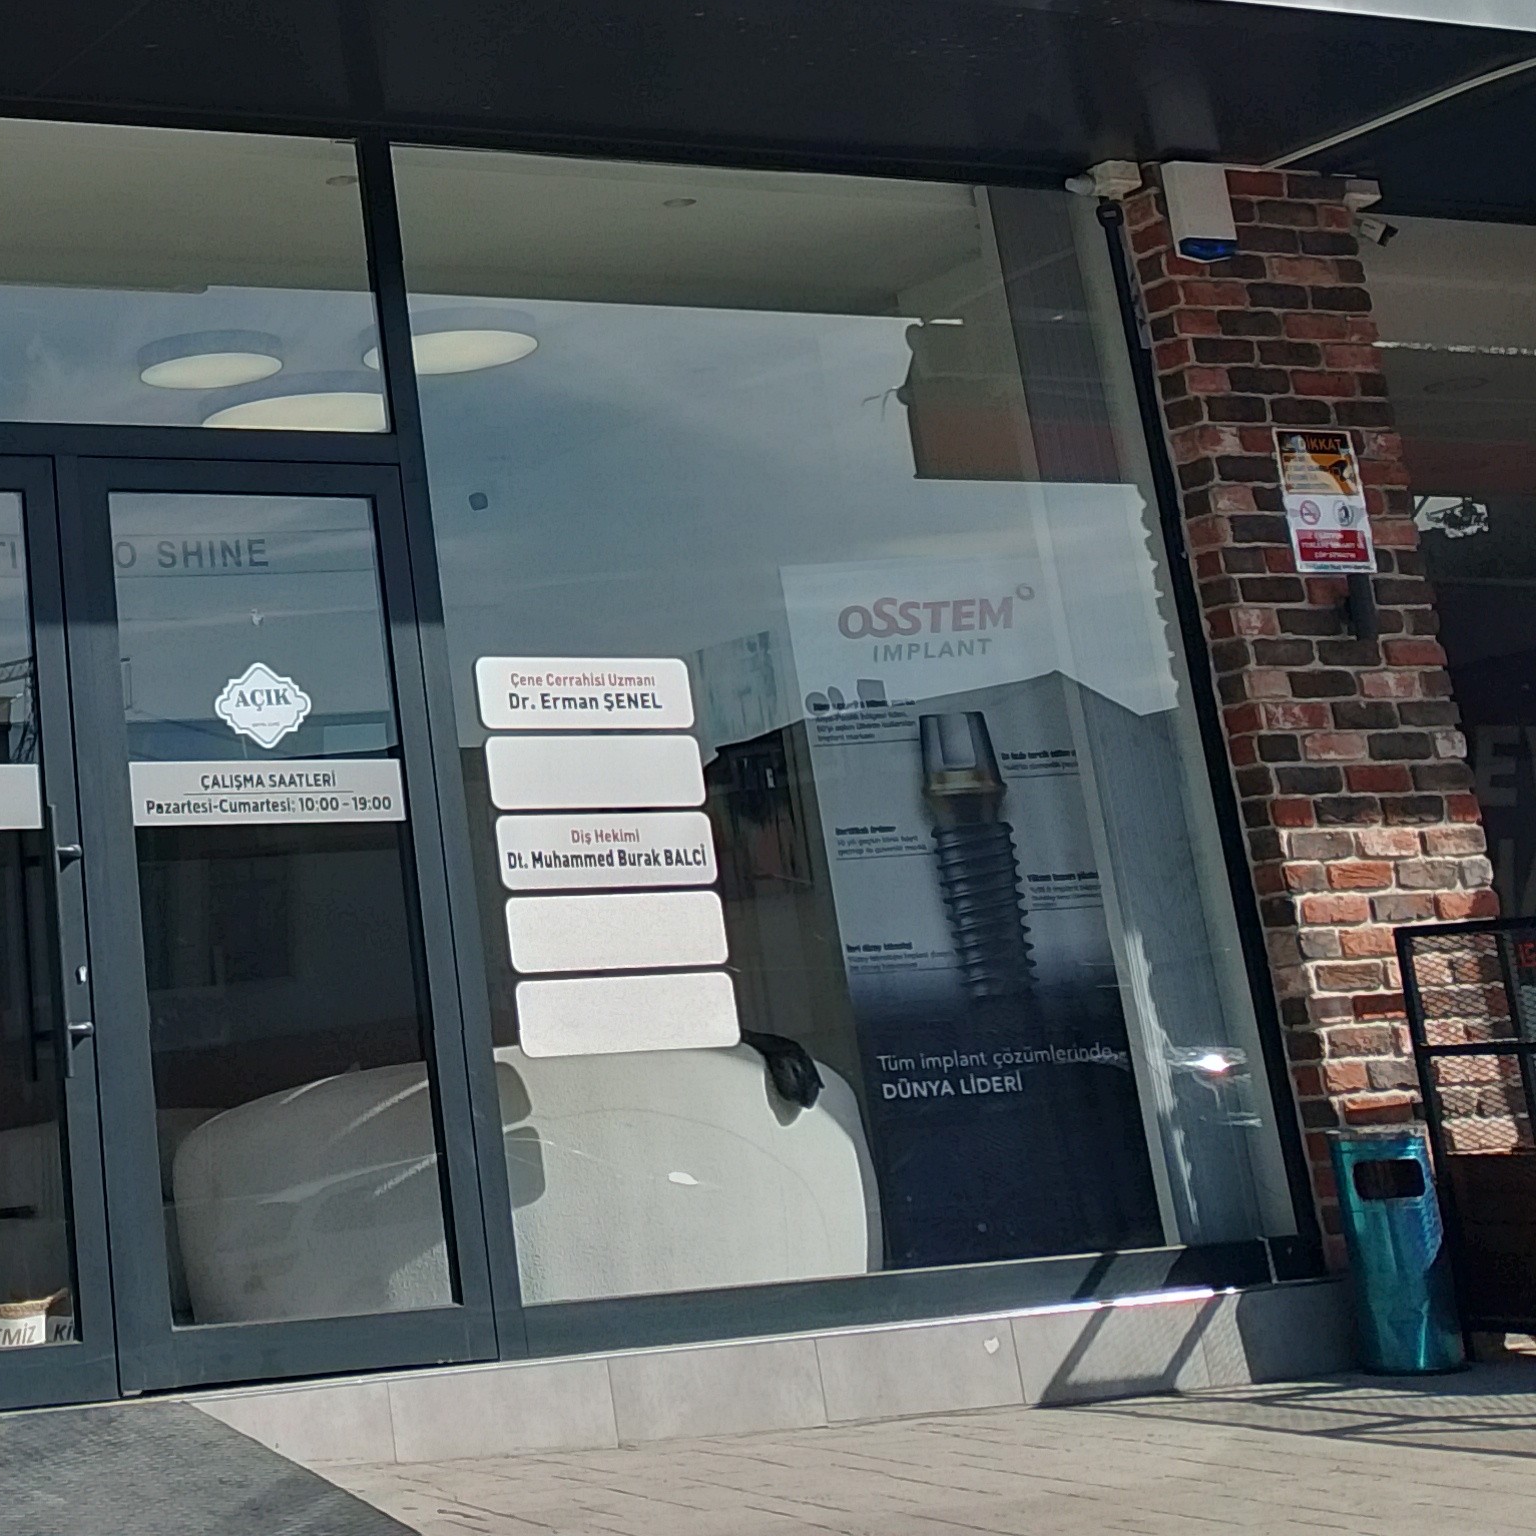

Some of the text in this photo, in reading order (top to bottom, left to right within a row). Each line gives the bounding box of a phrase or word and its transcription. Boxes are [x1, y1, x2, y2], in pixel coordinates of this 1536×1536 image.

[157, 538, 269, 569] SHINE
[873, 638, 993, 663] IMPLANT
[510, 672, 655, 689] Çene Cerrahisi Uzmanı
[235, 688, 292, 712] AÇIK
[508, 692, 663, 712] Dr. Erman ŞENEL
[200, 770, 336, 791] ÇALIŞMA SAATLERİ
[298, 797, 340, 812] 10:00
[353, 796, 393, 810] 19:00
[570, 828, 640, 845] Diş Hekimi
[507, 852, 529, 869] Dt.
[531, 850, 614, 869] Muhammed
[617, 848, 662, 867] Burak
[876, 1054, 916, 1072] Tüm
[920, 1050, 988, 1073] implant
[881, 1069, 1024, 1100] DÜNYA LİDERİ
